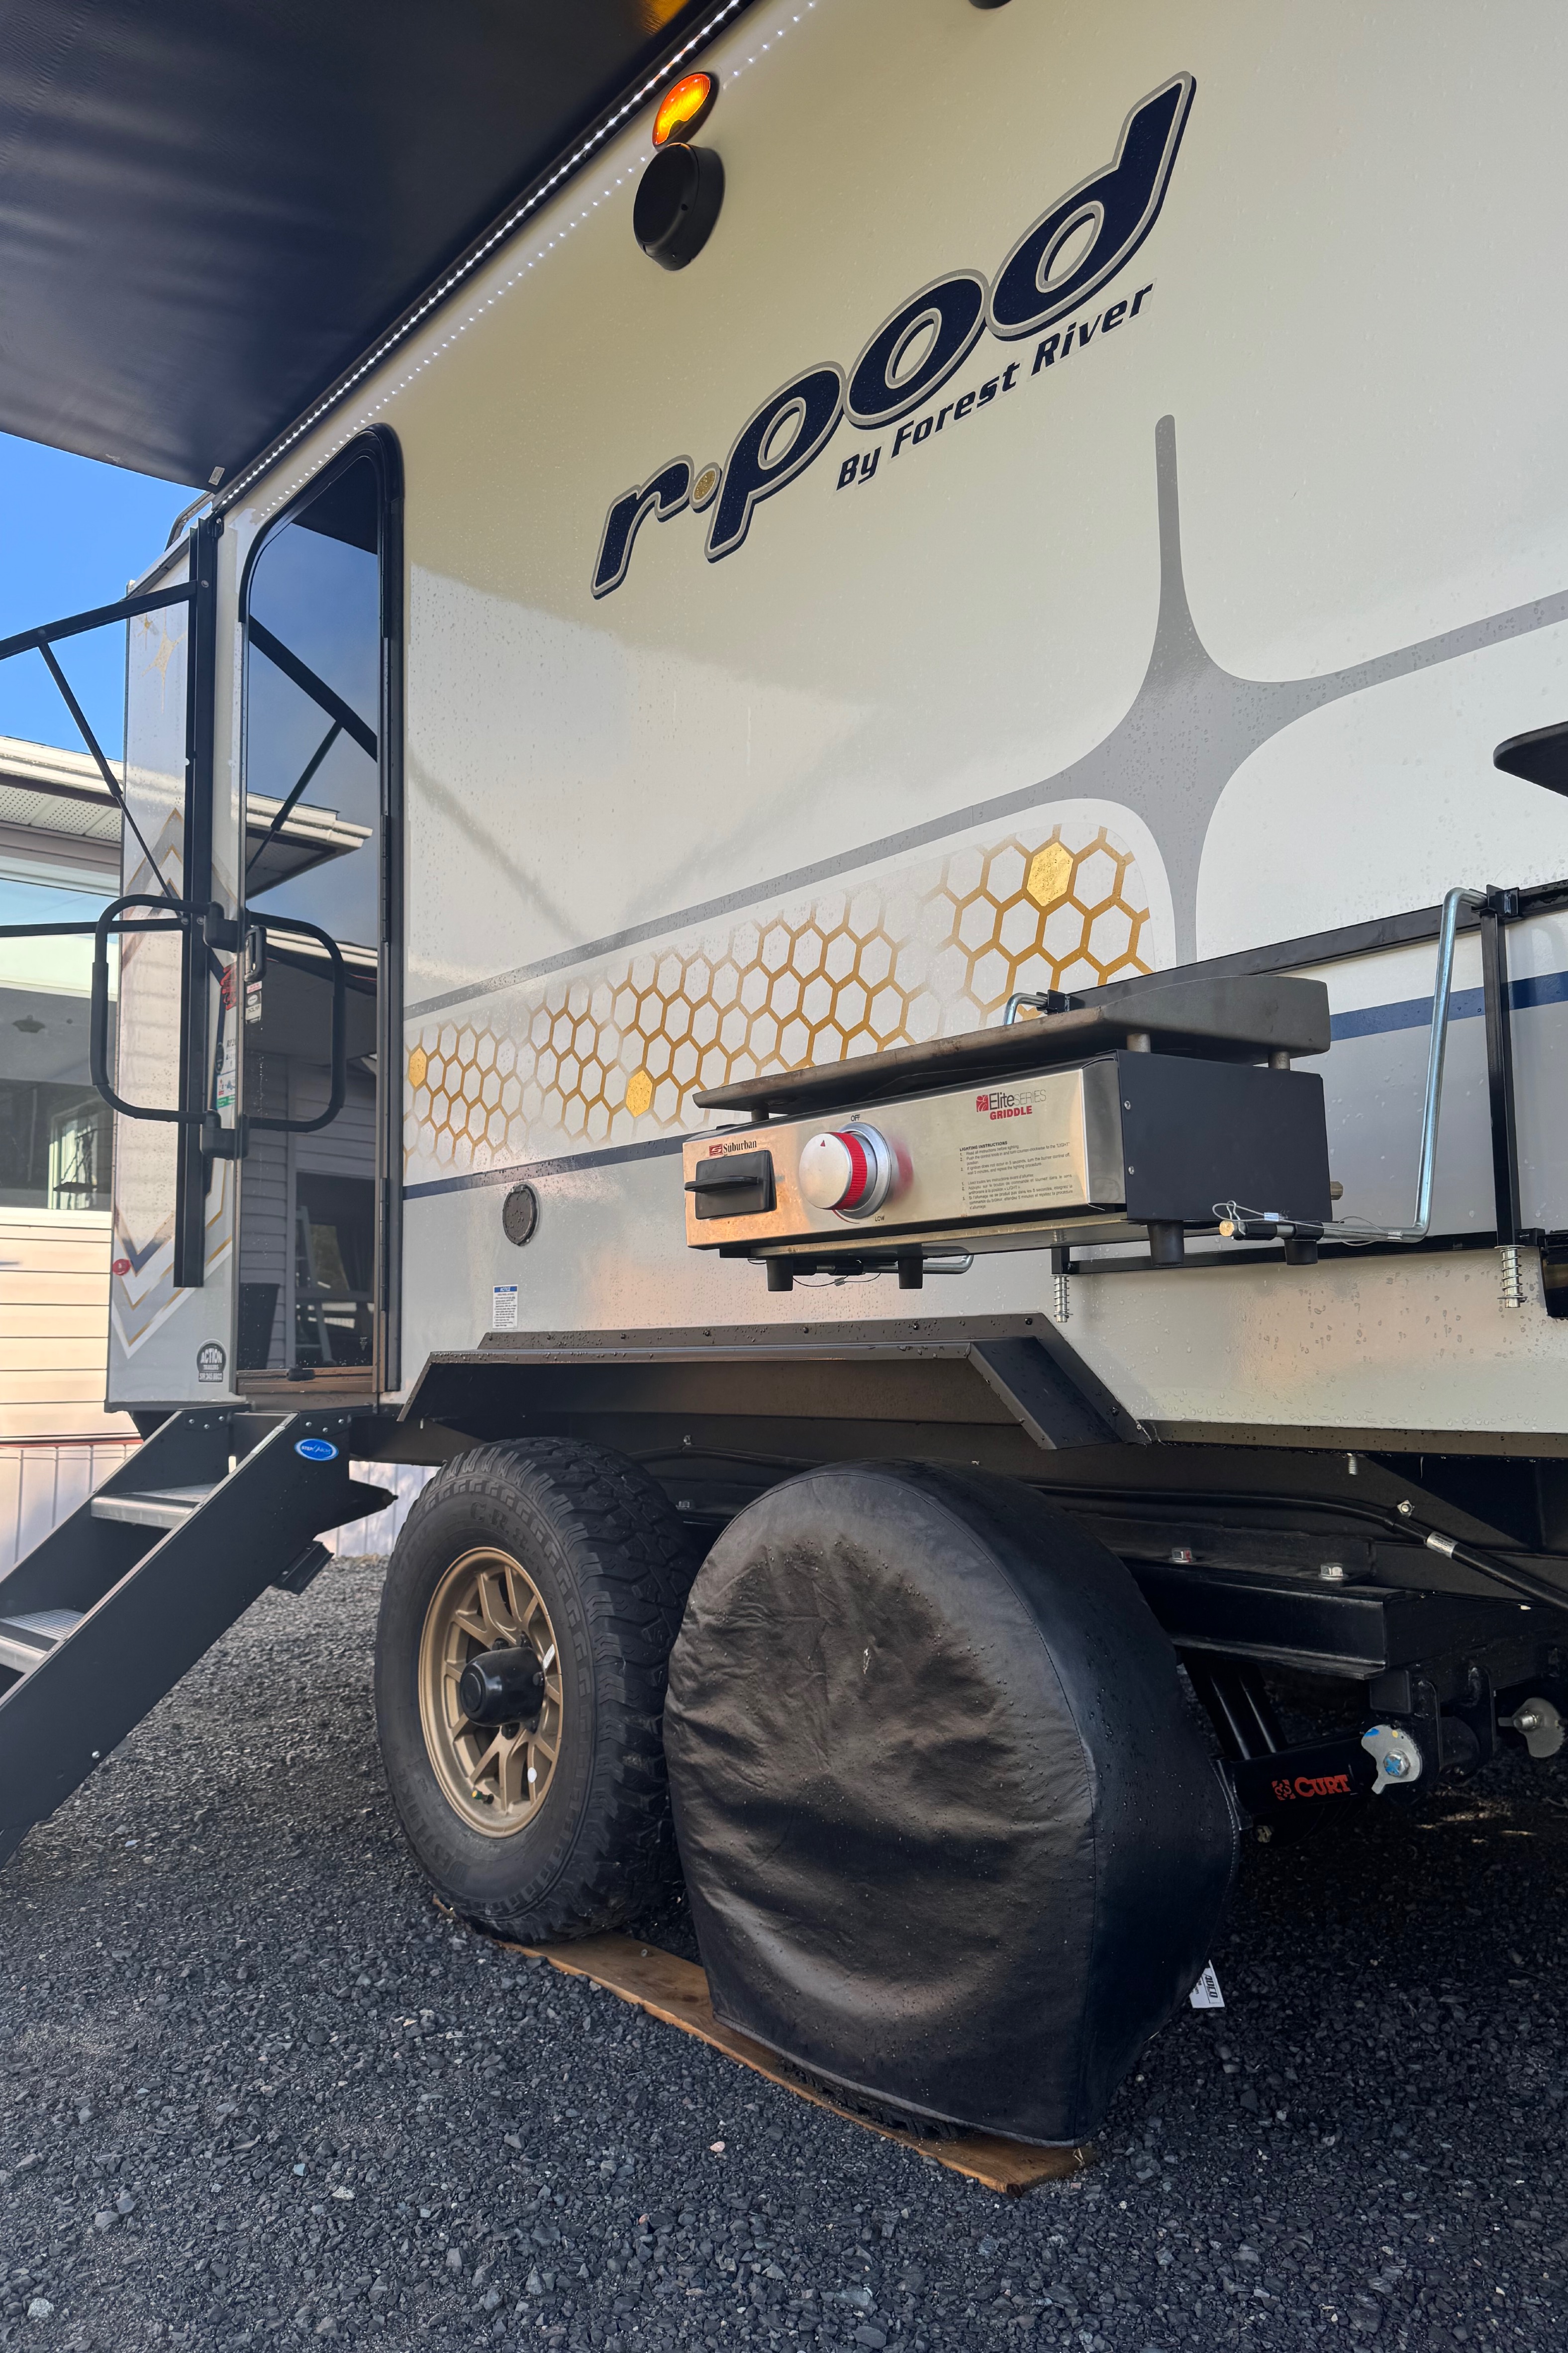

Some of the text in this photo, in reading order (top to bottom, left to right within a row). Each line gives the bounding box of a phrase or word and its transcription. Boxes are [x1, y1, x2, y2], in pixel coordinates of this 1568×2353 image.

[836, 283, 1154, 491] By Forest River
[989, 1105, 1033, 1121] GRIDDLE
[723, 1140, 757, 1153] Suburban
[200, 1348, 222, 1364] ACTION
[1294, 1774, 1351, 1797] CURT
